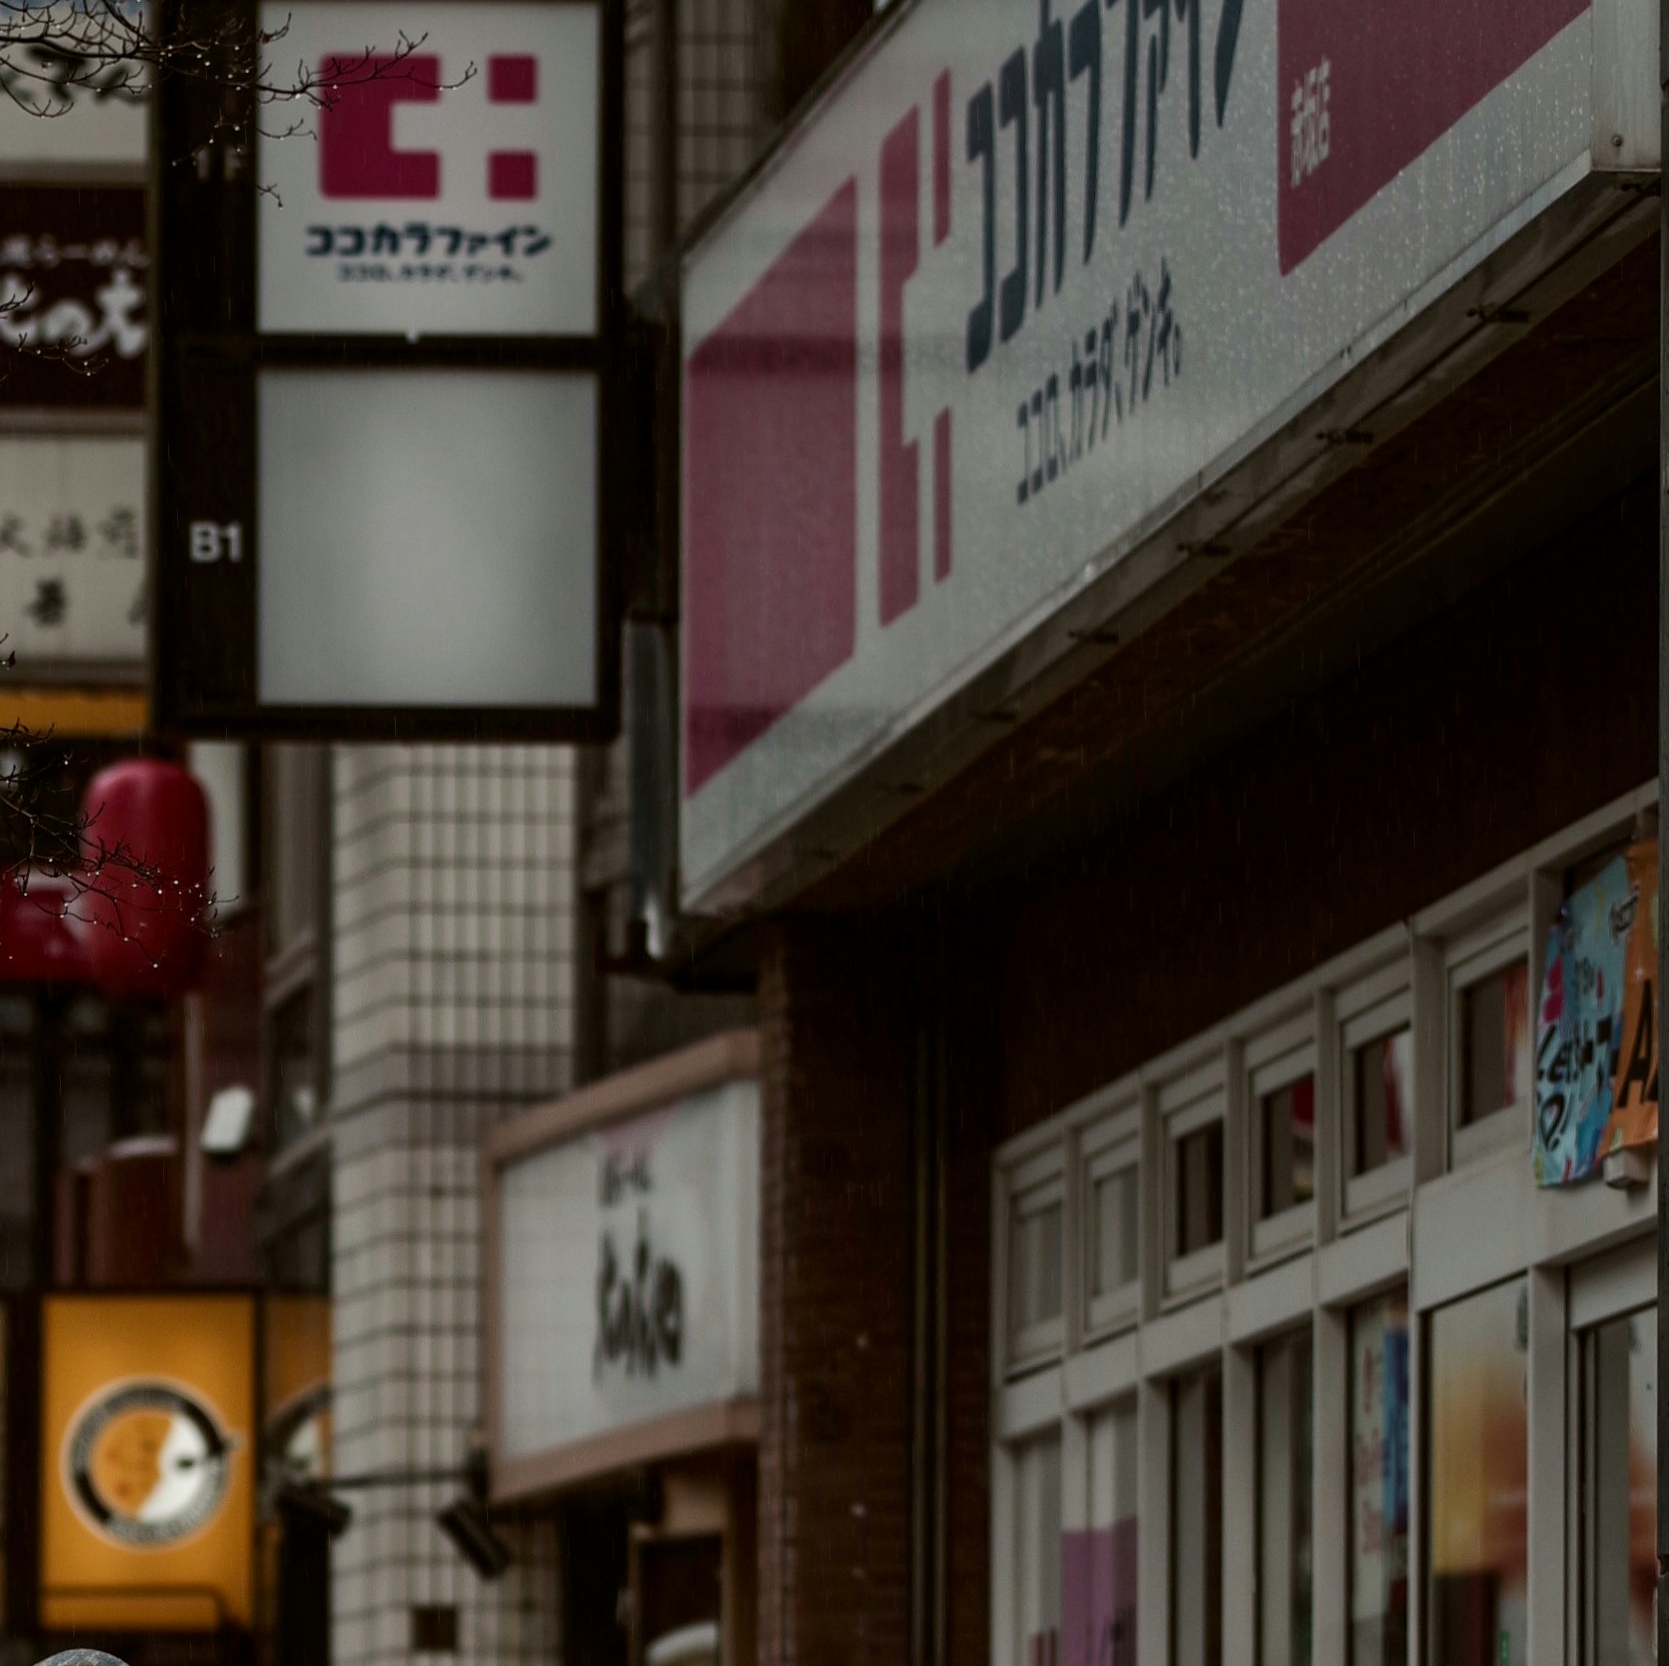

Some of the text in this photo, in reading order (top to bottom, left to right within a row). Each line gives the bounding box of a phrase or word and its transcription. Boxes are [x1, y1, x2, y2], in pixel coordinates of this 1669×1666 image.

[1290, 53, 1331, 191] 赤坂店
[304, 222, 552, 256] ココカラファイン
[188, 520, 243, 564] B1
